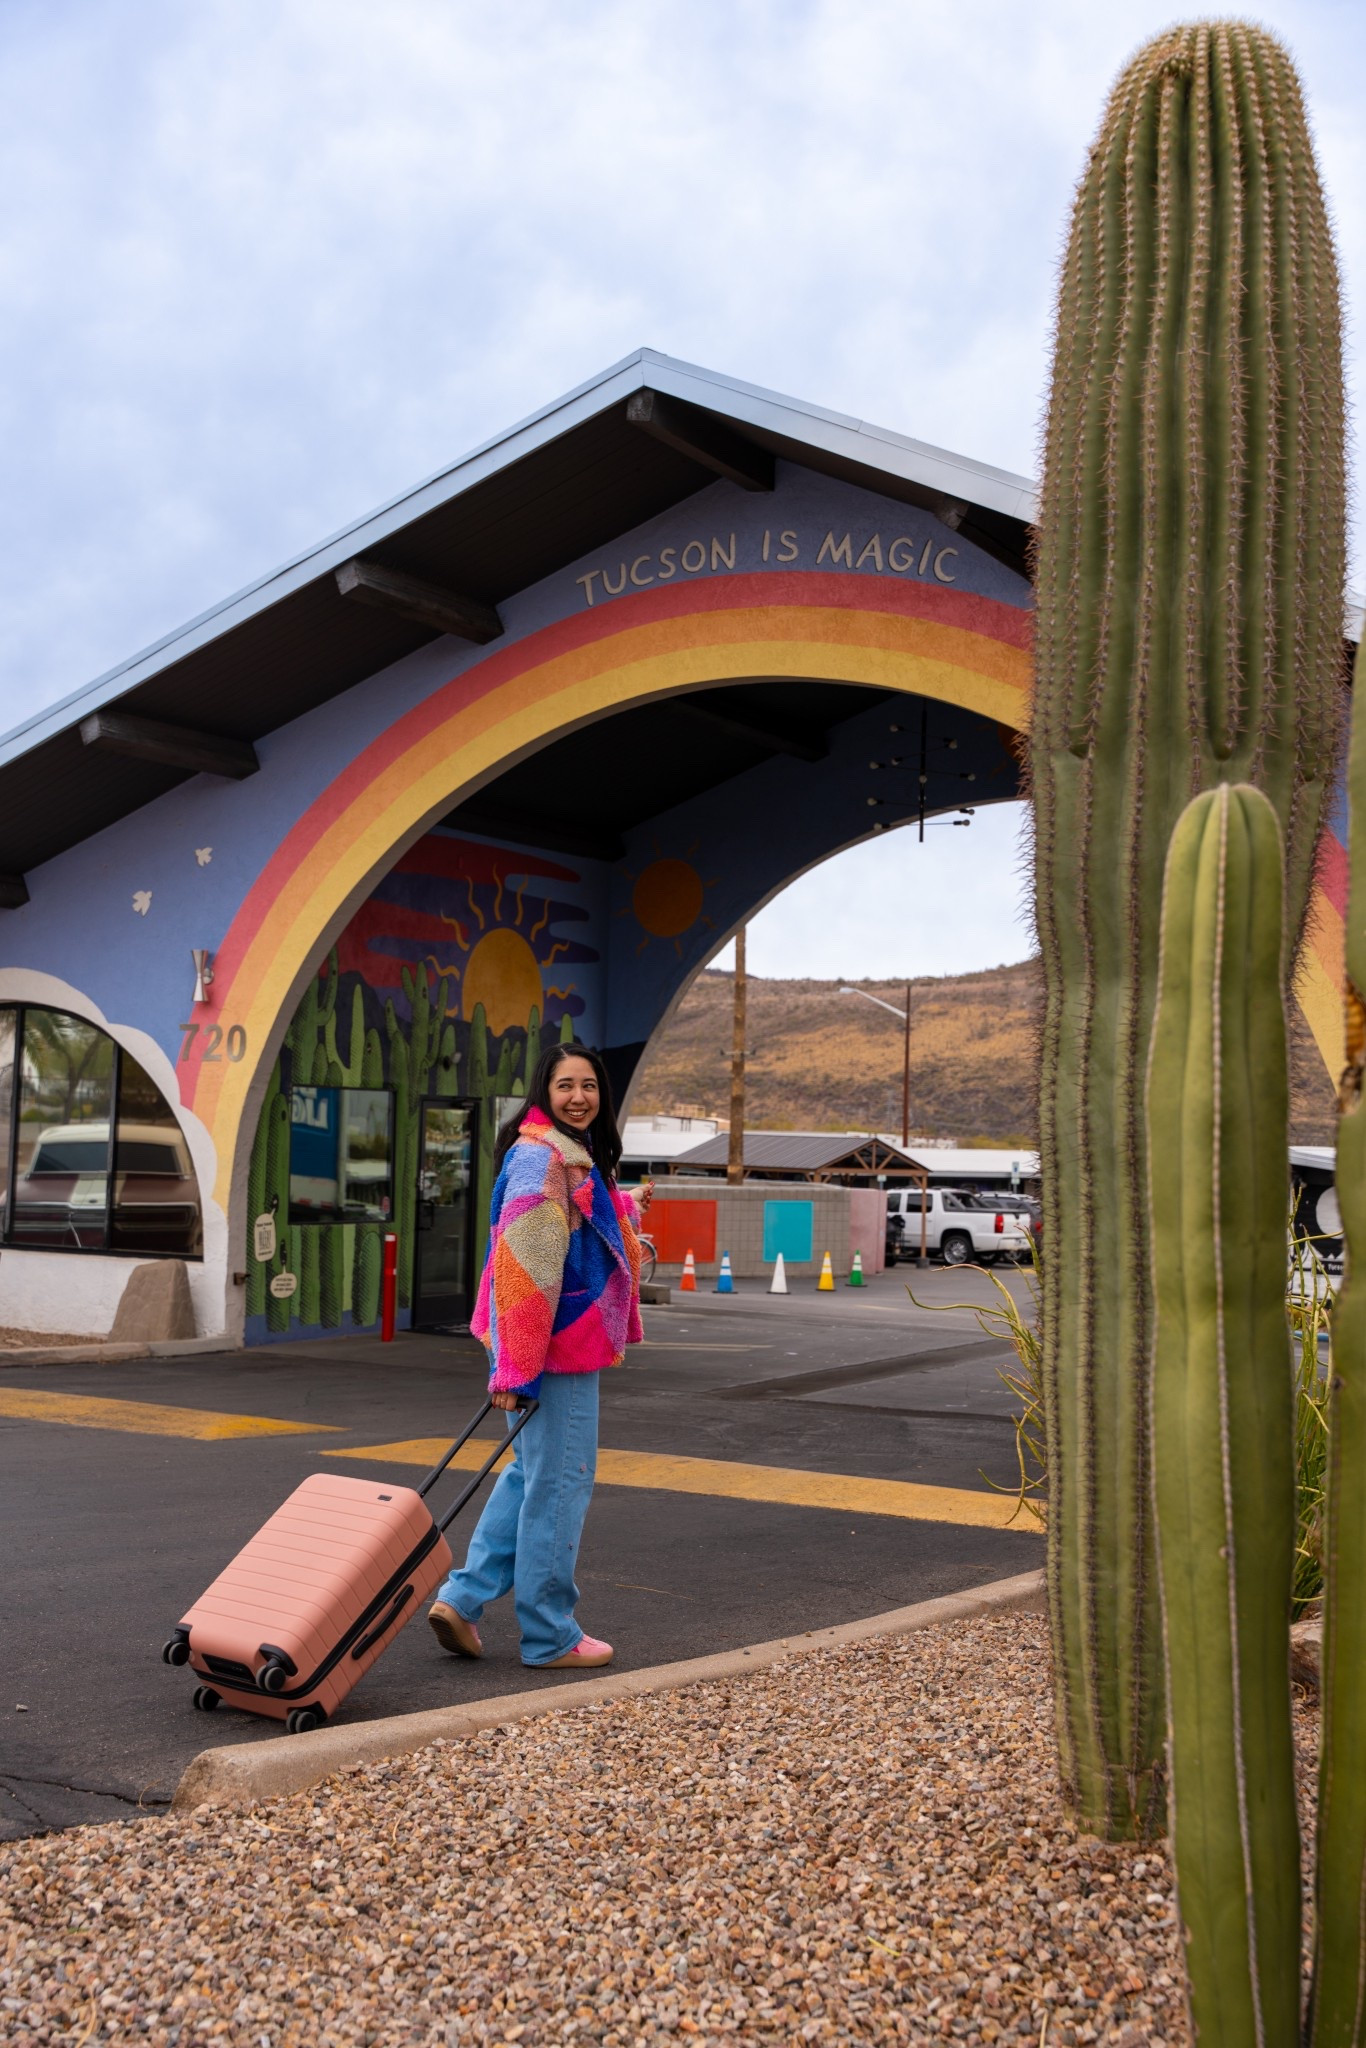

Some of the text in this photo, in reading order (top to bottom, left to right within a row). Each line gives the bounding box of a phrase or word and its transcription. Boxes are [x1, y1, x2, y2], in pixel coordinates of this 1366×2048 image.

[576, 529, 959, 606] TUCSON IS MAGIC
[179, 1023, 247, 1062] 720
